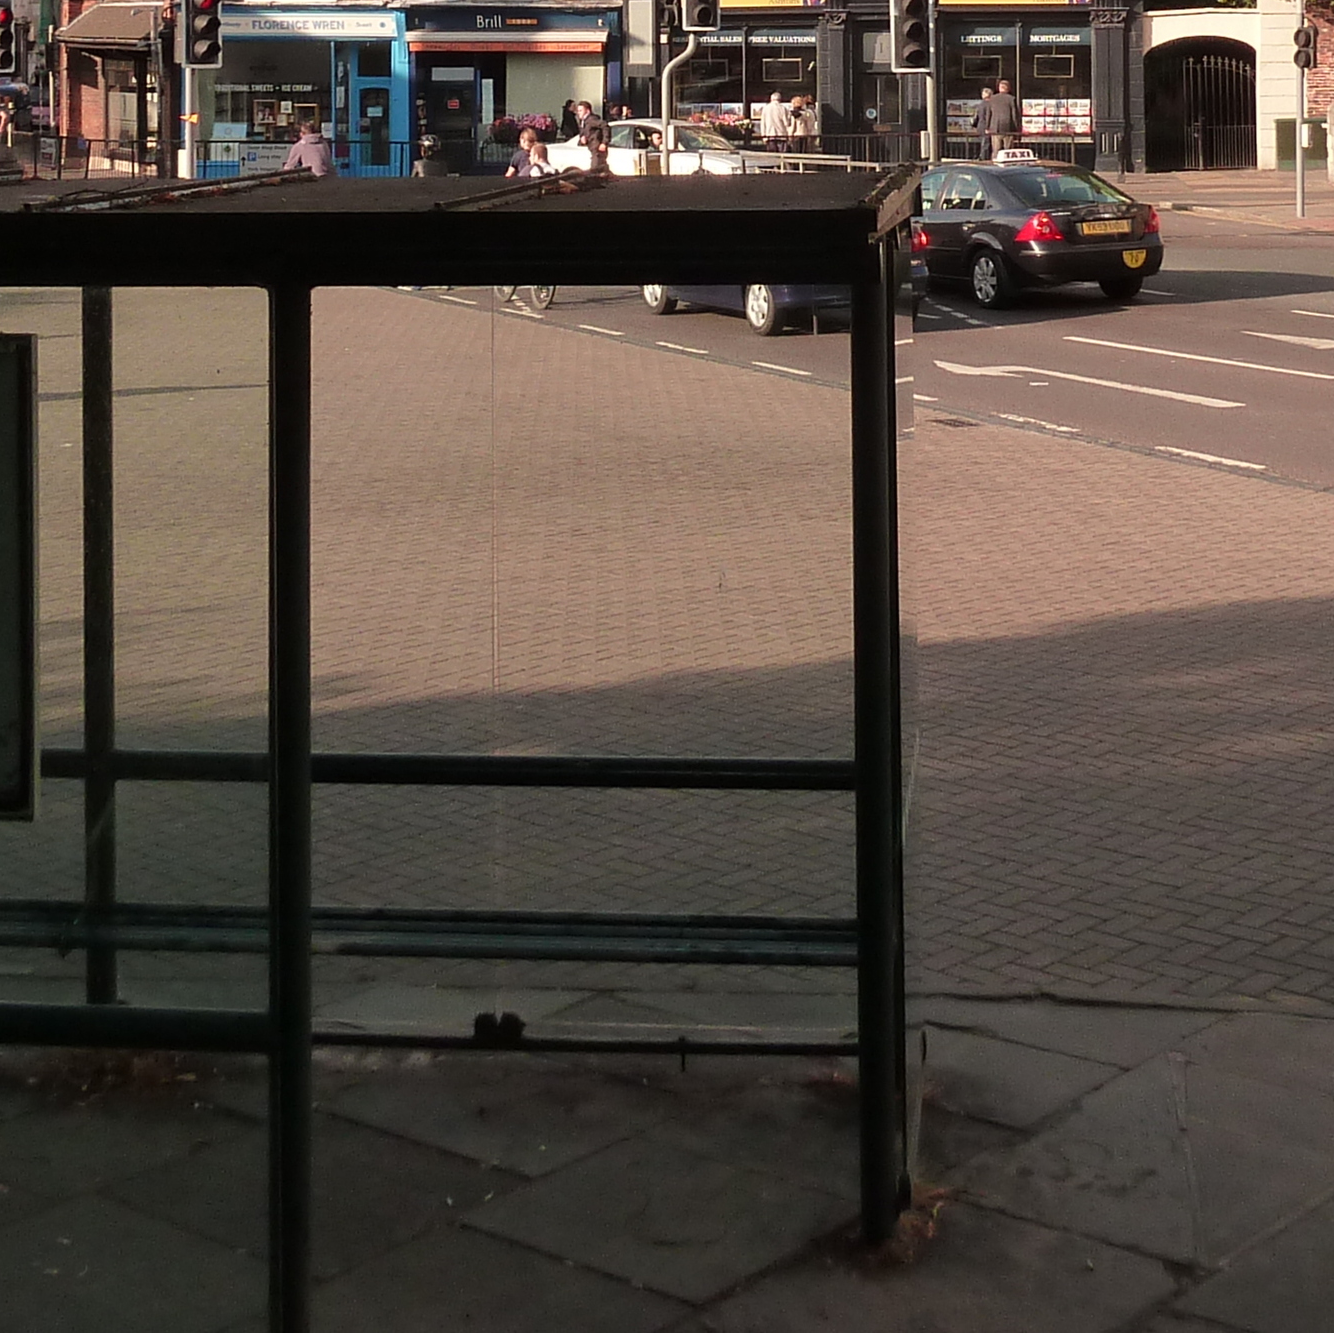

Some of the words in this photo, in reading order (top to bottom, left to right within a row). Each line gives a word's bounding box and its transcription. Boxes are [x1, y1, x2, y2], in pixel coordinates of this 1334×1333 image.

[251, 20, 310, 30] FLORENCE
[312, 20, 345, 30] WREN
[476, 15, 502, 29] Brill
[961, 35, 1002, 43] LETTINGS
[1029, 34, 1080, 43] MORTGAGES
[251, 84, 274, 92] SWEETS
[281, 84, 292, 92] ICE
[292, 84, 312, 92] CREAM
[1004, 151, 1031, 159] TAXI
